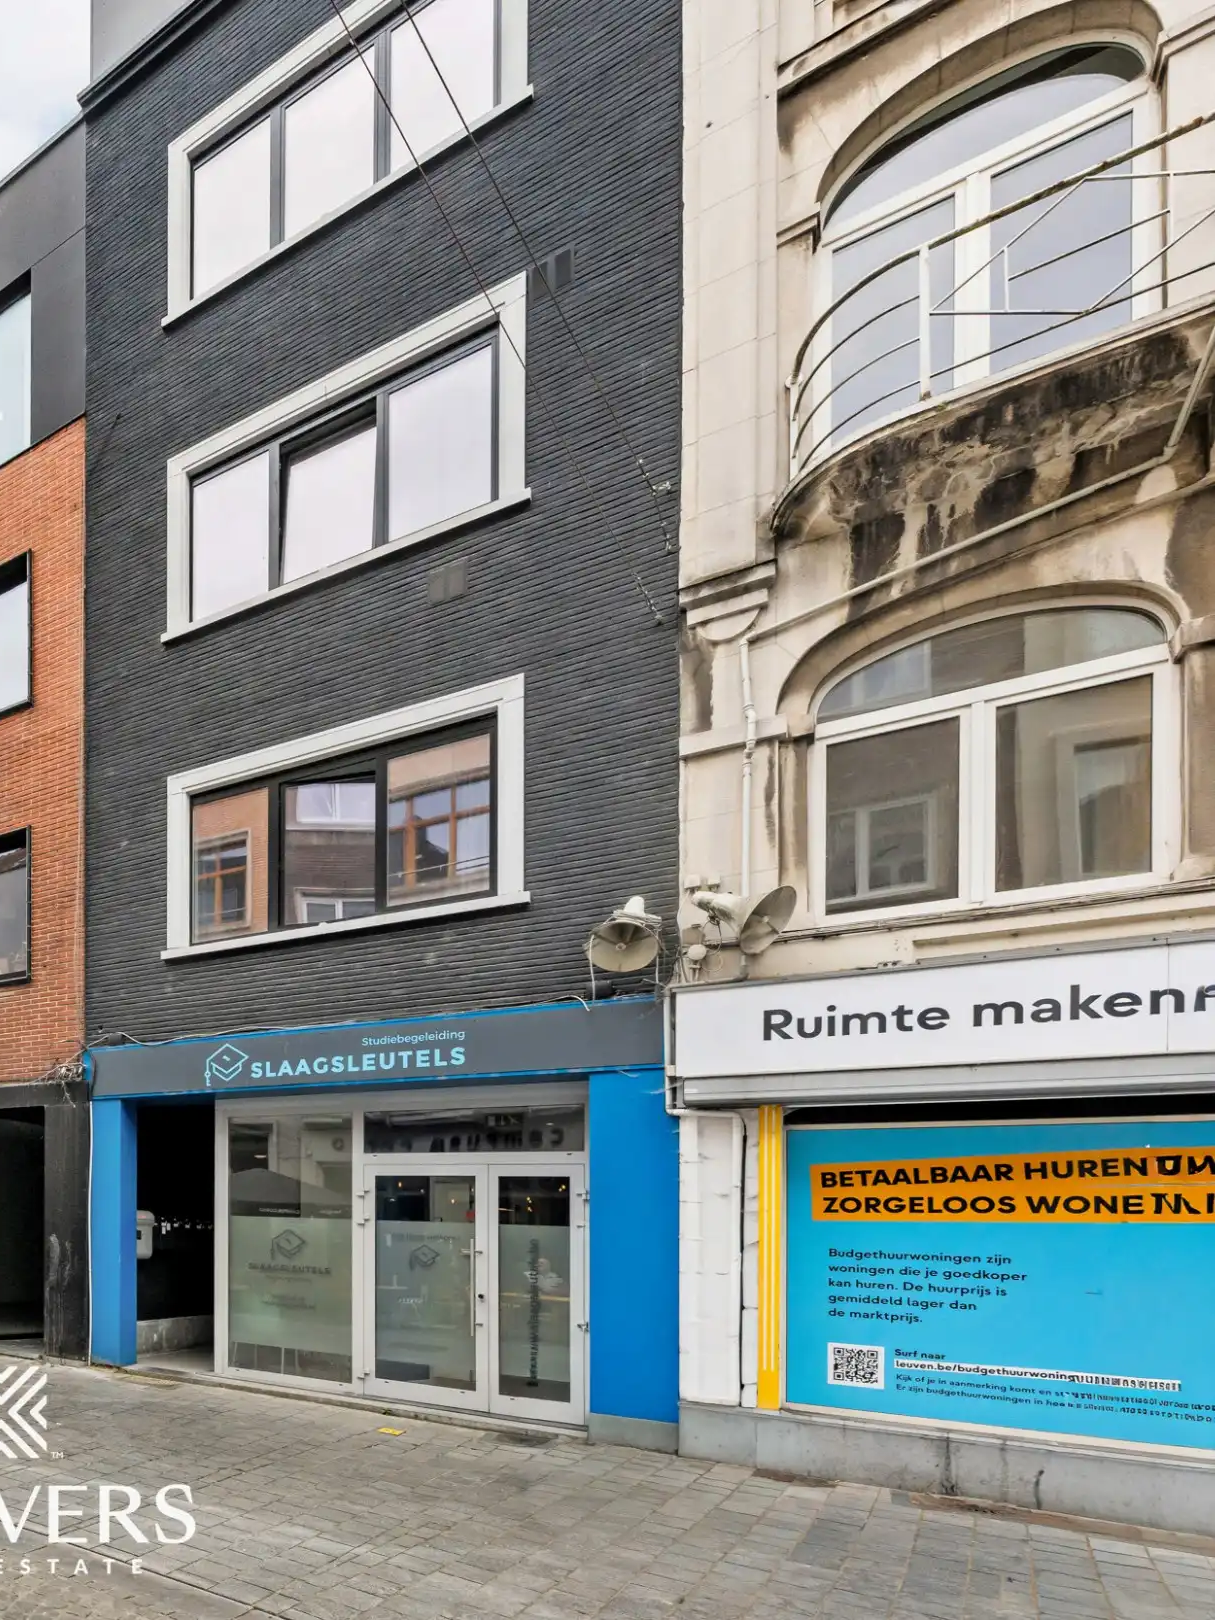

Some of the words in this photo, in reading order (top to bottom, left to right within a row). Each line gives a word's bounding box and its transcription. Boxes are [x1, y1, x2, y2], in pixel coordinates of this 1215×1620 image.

[763, 1004, 951, 1041] Ruimte
[361, 1030, 466, 1046] Studiebegeleiding
[251, 1047, 466, 1079] SLAAGSLEUTELS
[821, 1163, 1014, 1188] BETAALBAAR
[1023, 1157, 1148, 1180] HUREN
[823, 1196, 1017, 1214] ZORGELOOS
[828, 1248, 982, 1265] Budgethuurwoningen
[986, 1254, 1012, 1267] zijn
[828, 1264, 895, 1278] woningen
[899, 1265, 921, 1277] die
[924, 1267, 939, 1279] je
[943, 1269, 1028, 1283] goedkoper
[828, 1277, 852, 1288] kan
[856, 1279, 898, 1291] huren.
[903, 1281, 924, 1292] De
[928, 1283, 991, 1298] huurprijs
[996, 1286, 1008, 1297] is
[828, 1293, 903, 1306] gemiddeld
[907, 1297, 945, 1310] lager
[949, 1300, 978, 1311] dan
[828, 1307, 846, 1318] de
[849, 1309, 923, 1325] marktprijs.
[894, 1348, 918, 1358] Surf
[921, 1352, 947, 1360] naar
[896, 1373, 912, 1383] Kijk
[927, 1378, 936, 1386] je
[938, 1377, 947, 1385] in
[949, 1380, 1007, 1393] aanmerking
[1009, 1384, 1035, 1395] komt
[1038, 1388, 1052, 1396] en
[908, 1384, 924, 1394] zijn
[926, 1386, 1031, 1406] budgethuurwoningen
